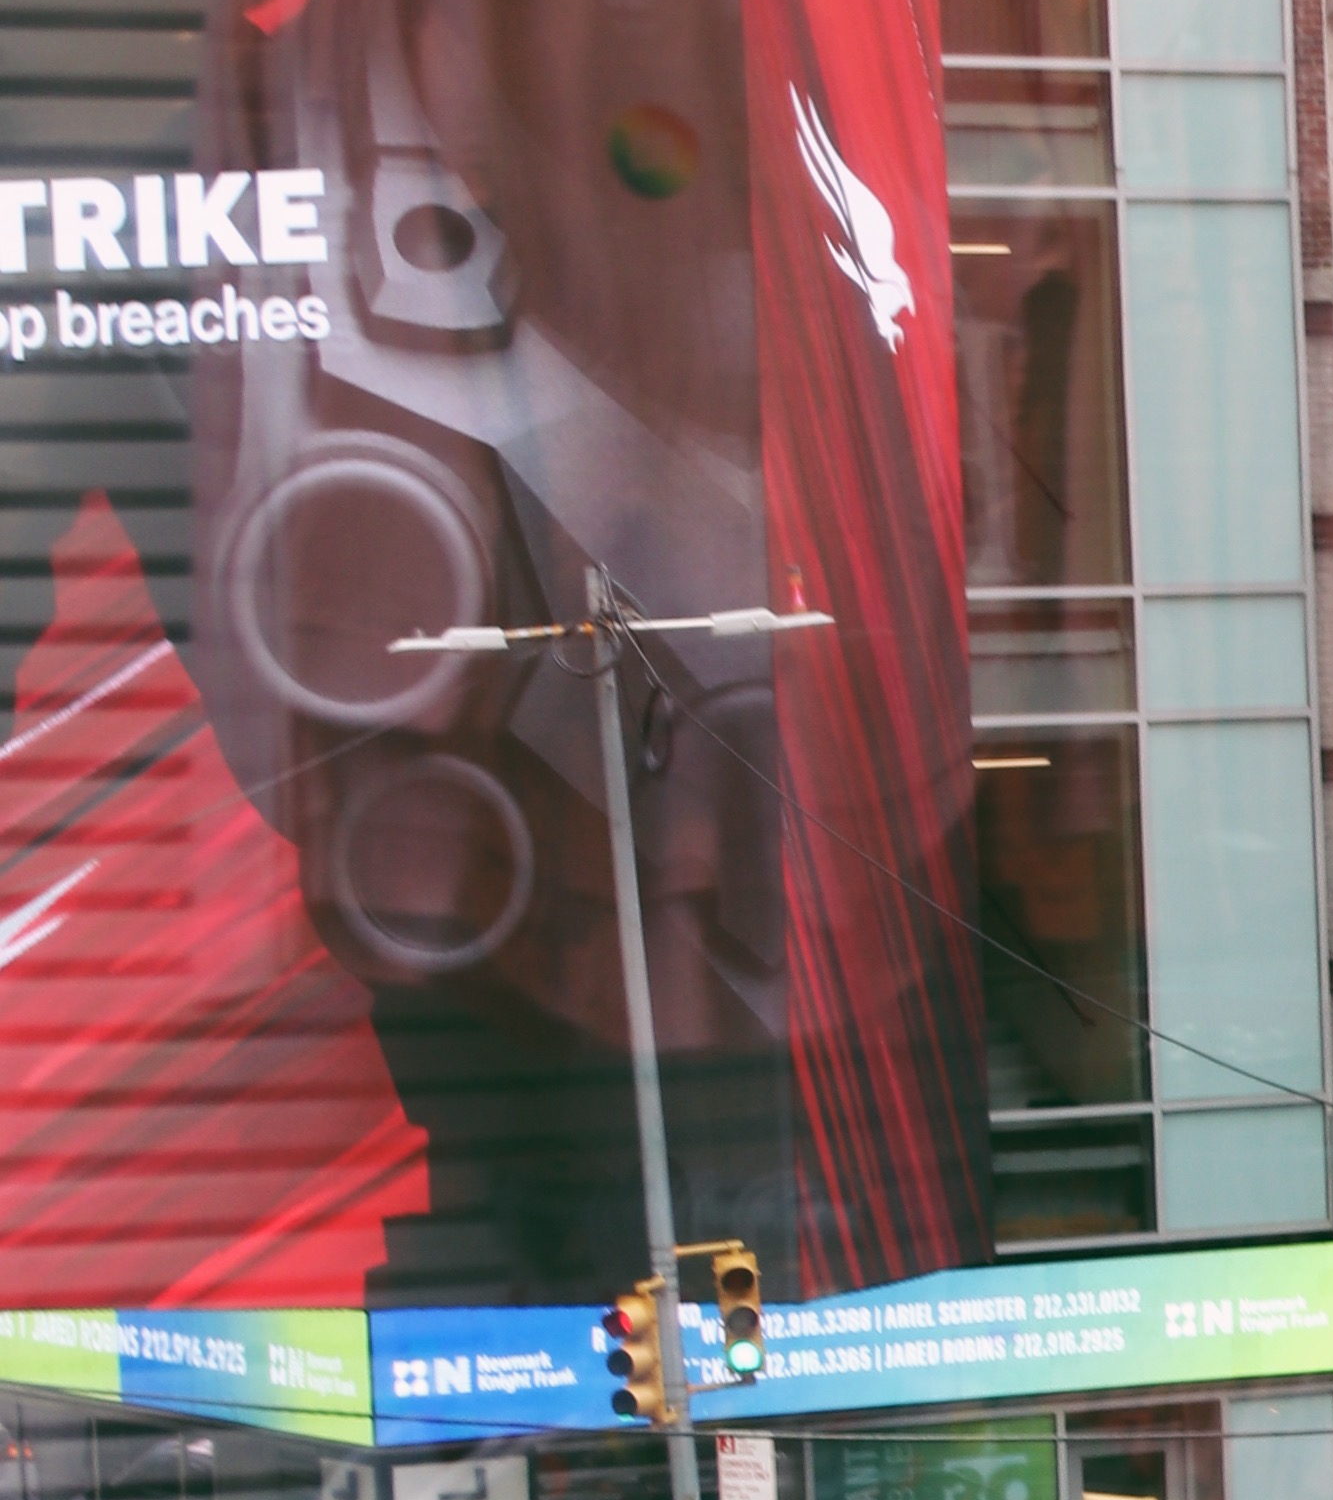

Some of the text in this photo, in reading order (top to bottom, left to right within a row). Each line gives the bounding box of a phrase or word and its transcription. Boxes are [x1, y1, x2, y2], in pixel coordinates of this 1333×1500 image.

[0, 168, 328, 276] TRIKE
[58, 286, 332, 349] breaches
[884, 1302, 936, 1332] ARIEL
[939, 1297, 1028, 1326] SCHUSTER
[475, 1350, 554, 1376] Newmark
[884, 1336, 939, 1369] JARED
[942, 1333, 1006, 1364] ROBINS
[533, 1368, 578, 1390] Frank
